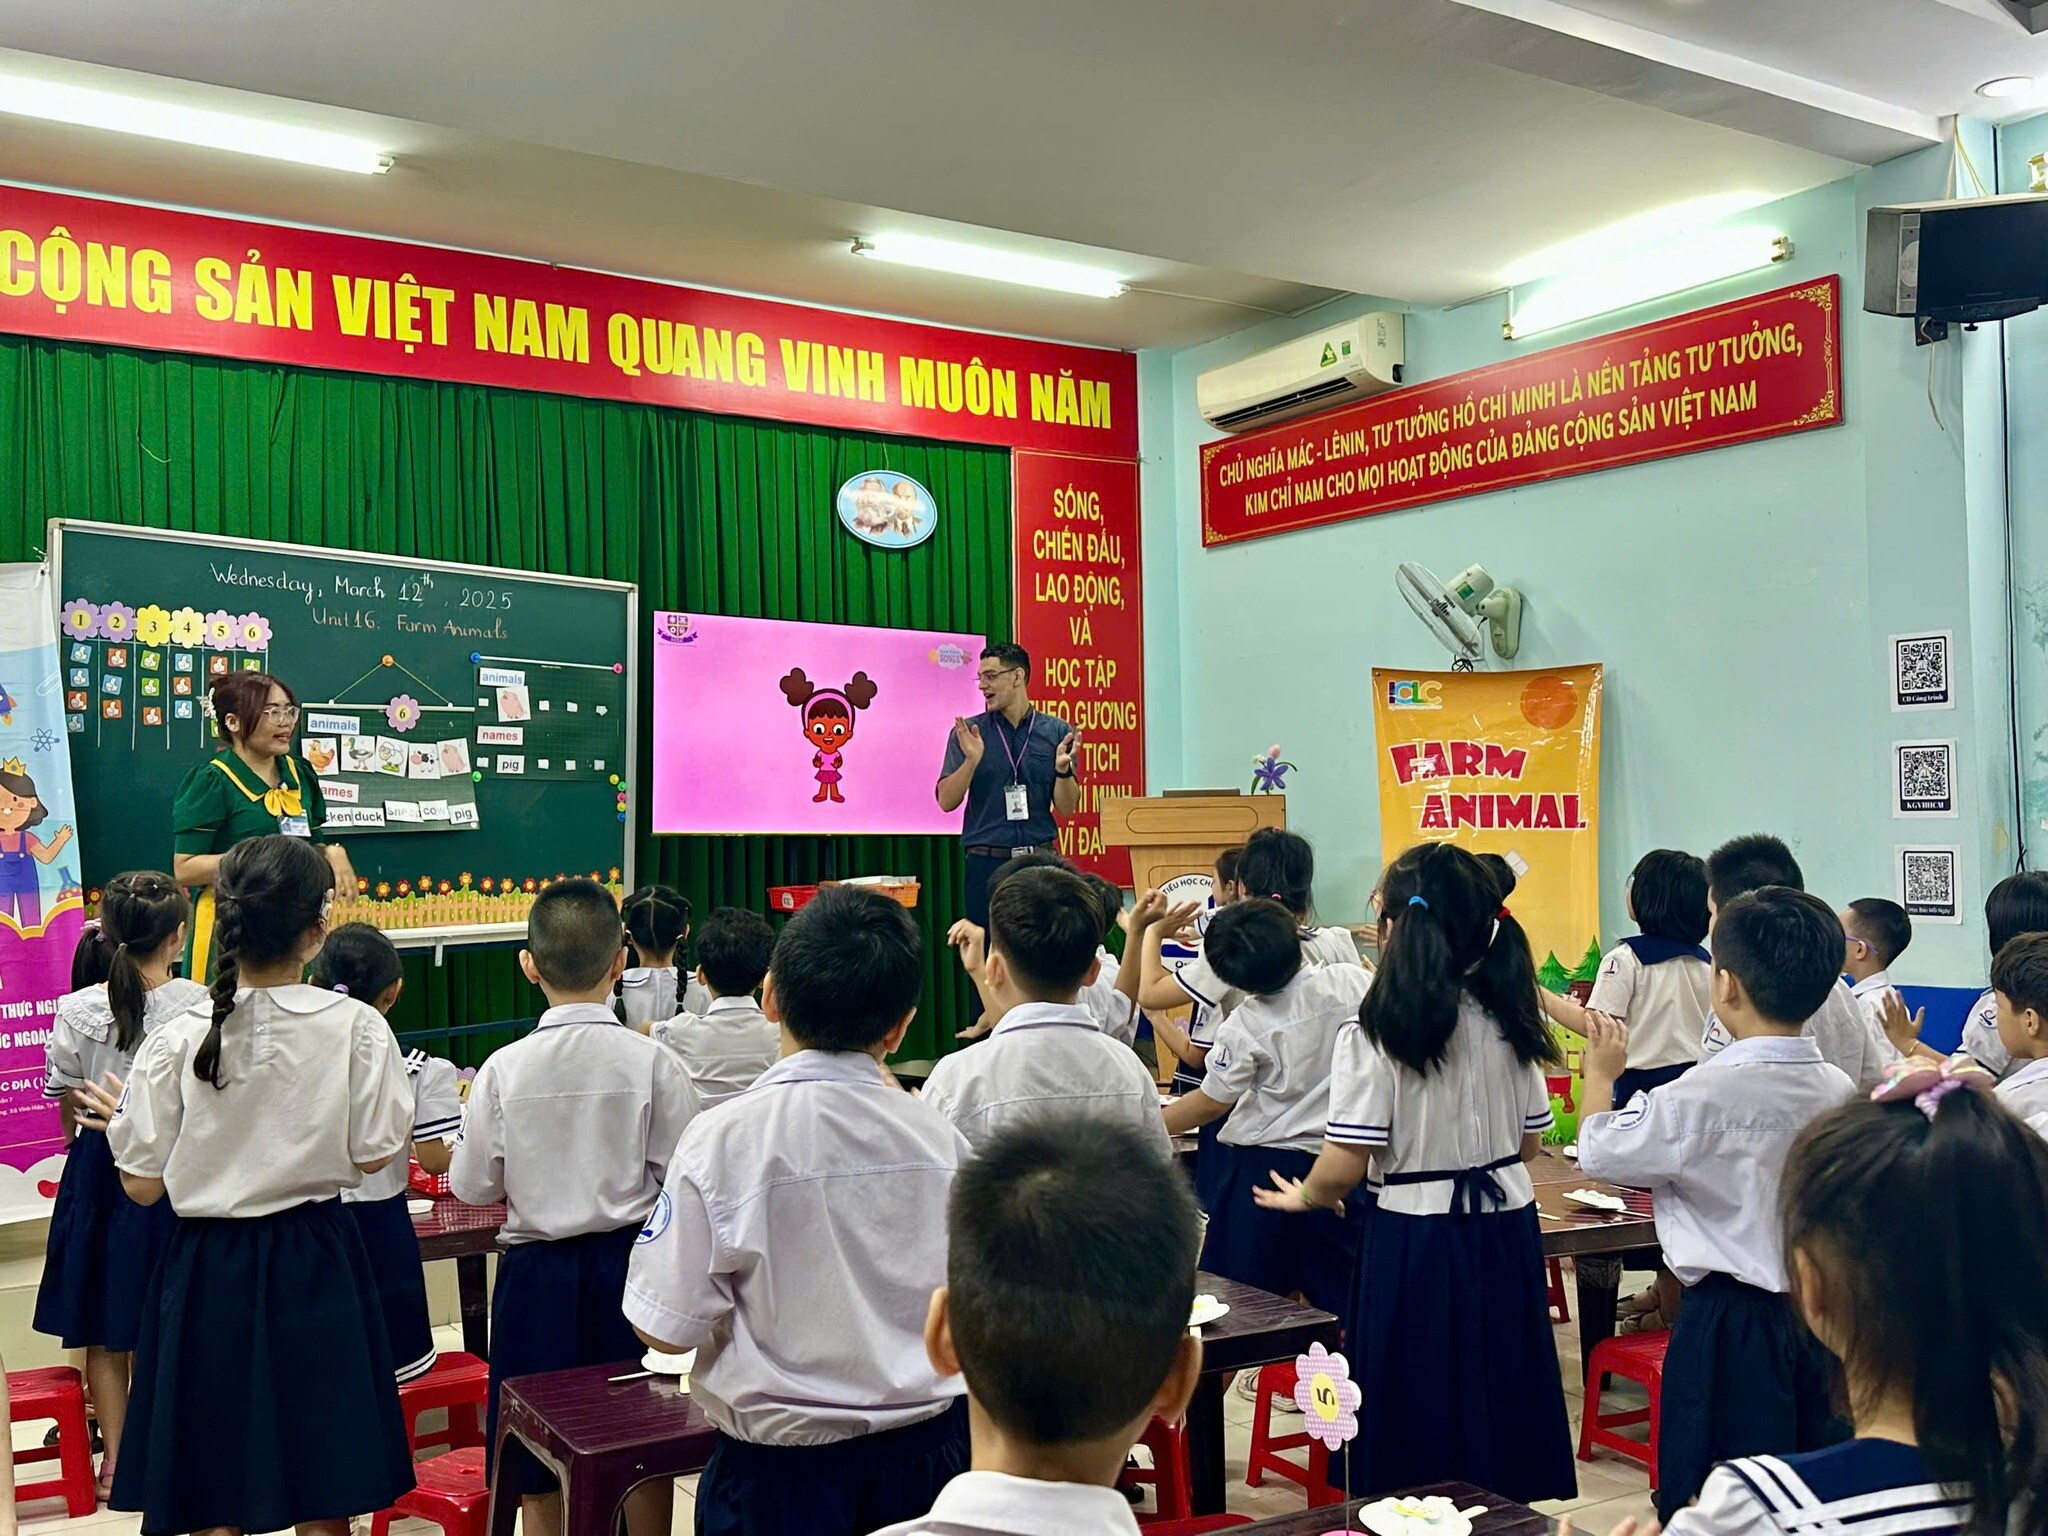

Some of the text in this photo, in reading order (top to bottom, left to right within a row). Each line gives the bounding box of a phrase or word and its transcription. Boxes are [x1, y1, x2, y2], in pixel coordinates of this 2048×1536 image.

[0, 226, 1111, 429] CỘNG SẢN VIỆT NAM QUANG VINH MUÔN NĂM
[1220, 454, 1243, 487] CHỦ
[1246, 447, 1285, 480] NGHĨA
[1287, 438, 1314, 470] MÁC
[1324, 430, 1369, 461] LÊNIN,
[1372, 421, 1392, 449] TƯ
[1395, 405, 1449, 443] TƯỞNG
[1453, 391, 1475, 430] HỒ
[1479, 386, 1507, 423] CHÍ
[1511, 384, 1556, 416] MINH
[1561, 368, 1583, 404] LÀ
[1587, 357, 1625, 398] NỀN
[1630, 348, 1680, 388] TẢNG
[1685, 341, 1715, 375] TƯ
[1719, 320, 1803, 367] TƯỞNG,
[1245, 380, 1757, 517] KIM CHỈ NAM CHO MỌI HOẠT ĐỘNG CỦA ĐẢNG CỘNG SẢN VIỆT NAM
[1053, 484, 1104, 523] SỐNG,
[1033, 525, 1125, 569] CHIẾN ĐẤU,
[210, 563, 323, 604] Wednesday,
[334, 575, 386, 598] March
[460, 588, 513, 610] 2025
[1036, 572, 1125, 610] LAO ĐỘNG,
[78, 614, 256, 638] 1 2 3 4 5 6
[312, 608, 349, 627] Unit
[397, 614, 437, 634] Farm
[443, 616, 508, 640] Animals
[1069, 610, 1092, 646] VÀ
[482, 671, 523, 685] animals
[1045, 655, 1117, 691] HỌC TẬP
[310, 717, 357, 731] animals
[399, 708, 406, 719] 6
[1075, 700, 1137, 730] GƯƠNG
[483, 731, 518, 741] names
[502, 759, 519, 771] pig
[1083, 743, 1120, 778] TỊCH
[1389, 739, 1529, 786] FARM
[321, 786, 353, 798] ames
[355, 811, 383, 822] duck
[455, 808, 473, 820] pig
[1419, 793, 1587, 830] ANIMAL
[1058, 820, 1106, 862] VĨ ĐẠ
[459, 1084, 467, 1097] 1
[1316, 1387, 1335, 1406] 5
